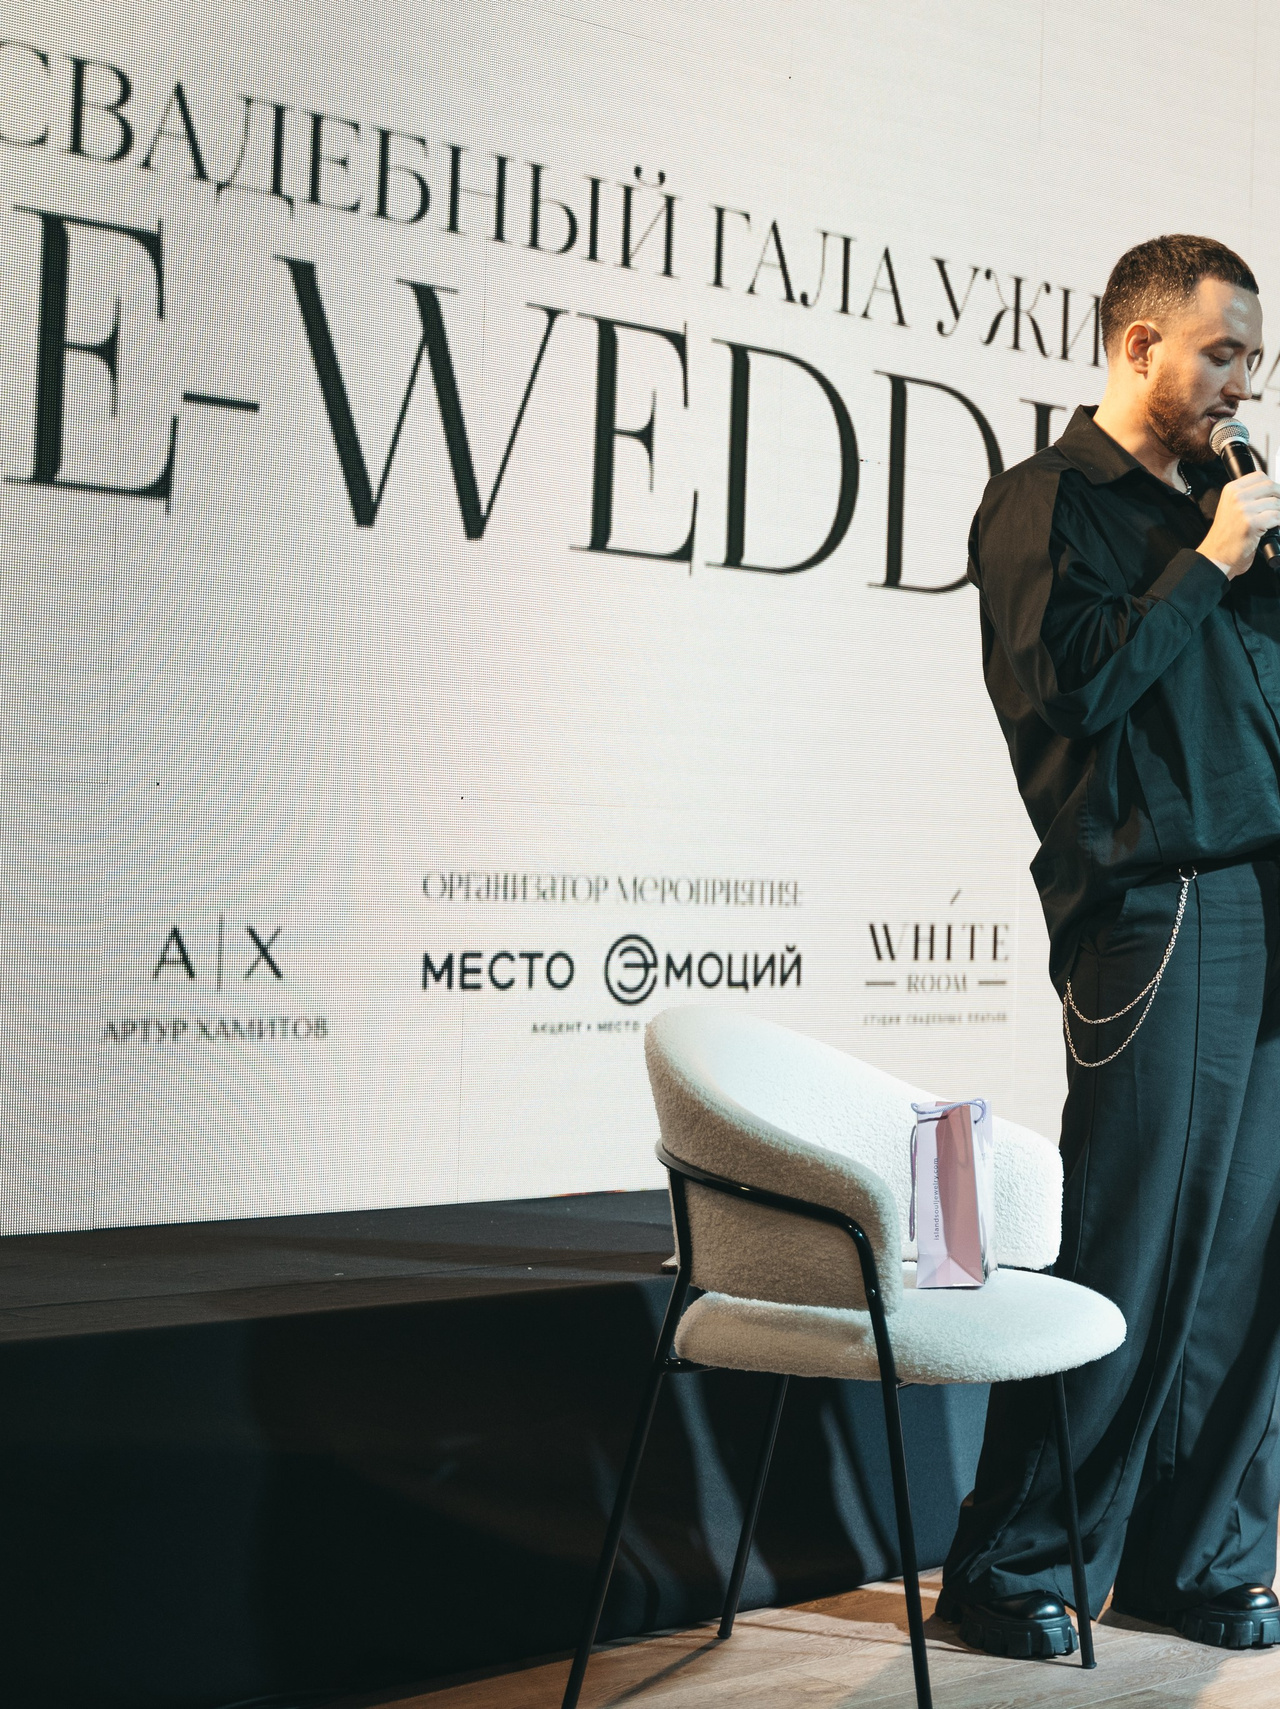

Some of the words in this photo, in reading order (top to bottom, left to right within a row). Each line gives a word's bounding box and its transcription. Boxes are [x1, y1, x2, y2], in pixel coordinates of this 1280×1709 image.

[705, 203, 912, 328] ГАЛА
[931, 256, 1104, 369] УЖИ
[2, 203, 1268, 595] E-WEDD
[422, 950, 576, 991] МЕСТО
[604, 933, 802, 1007] ЭМОЦИЙ
[868, 922, 1010, 962] WHITE
[907, 973, 968, 994] ROOM
[103, 1016, 189, 1042] АРТУР
[196, 1015, 329, 1041] ХАМИТОВ
[933, 1157, 941, 1241] islandsouljewelry.com
